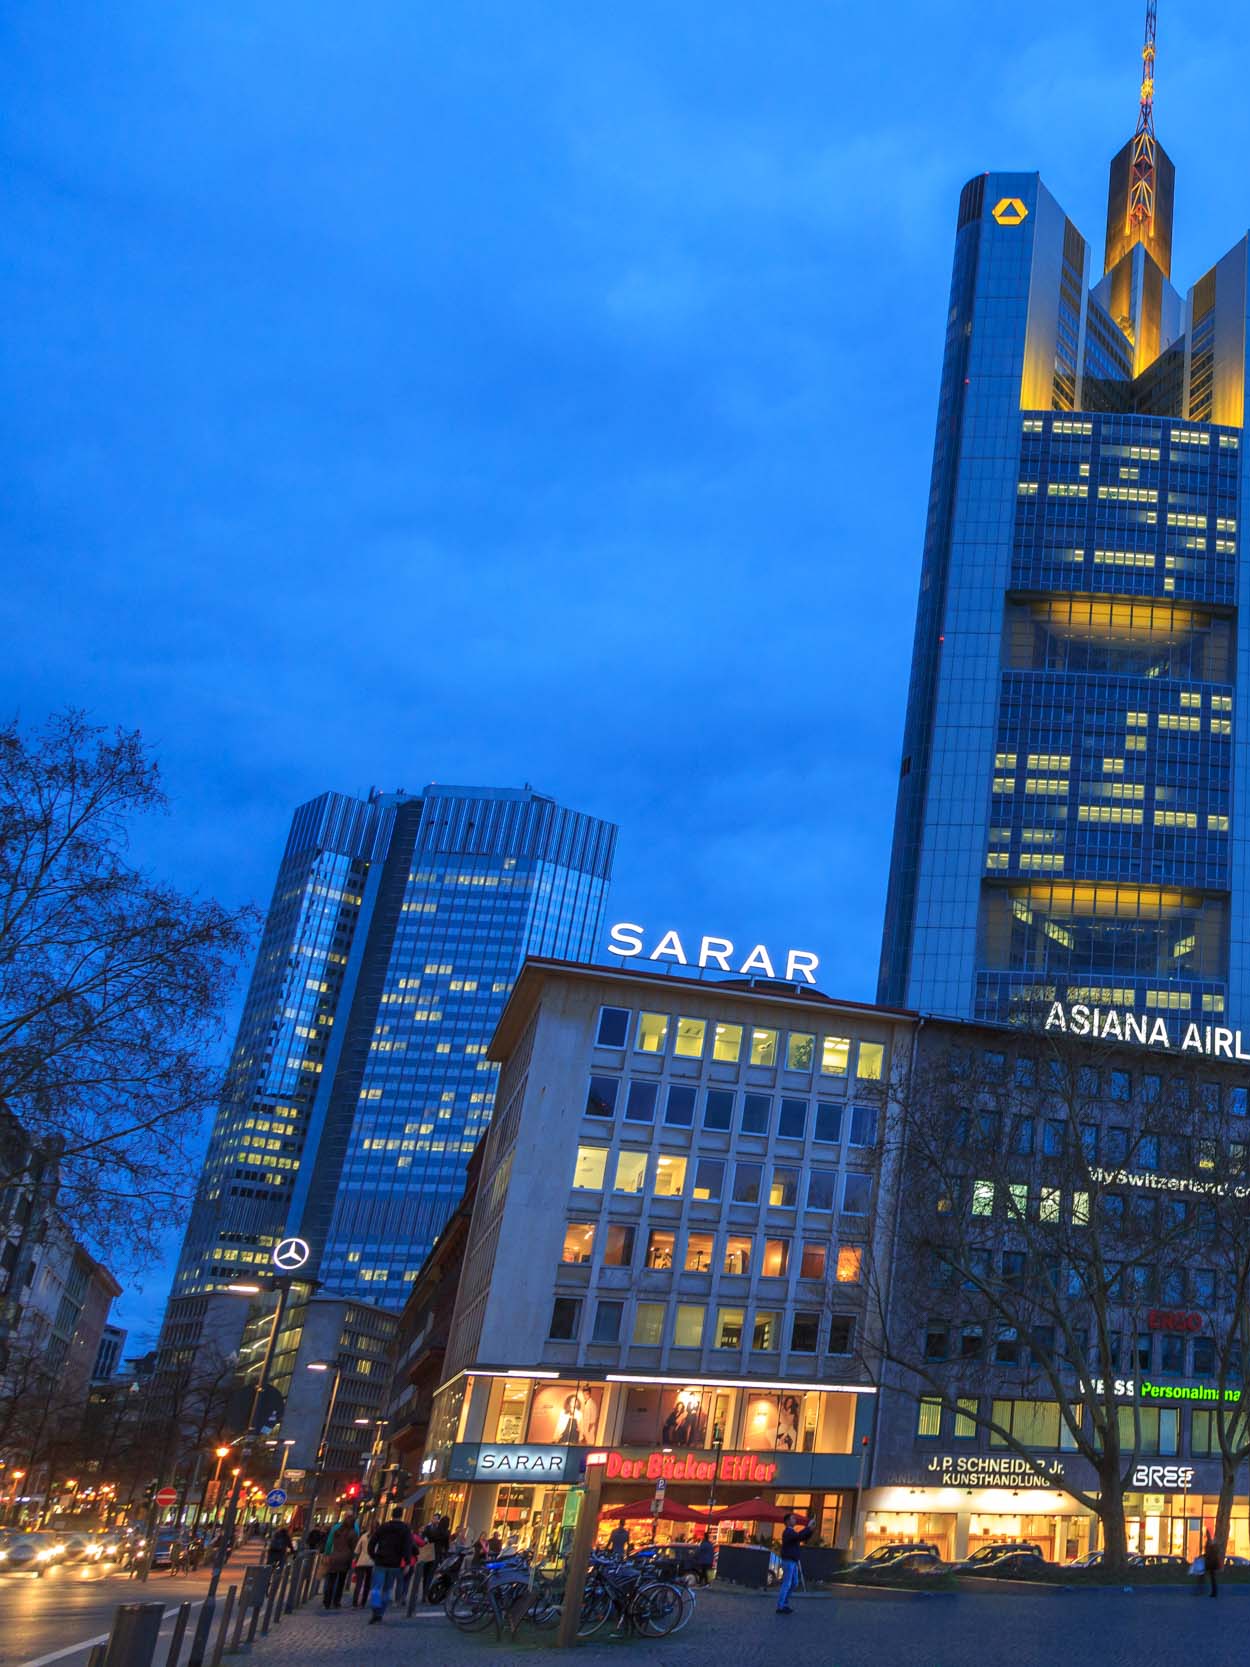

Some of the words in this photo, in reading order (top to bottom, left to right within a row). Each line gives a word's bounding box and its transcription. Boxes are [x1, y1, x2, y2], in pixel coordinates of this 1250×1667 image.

[607, 922, 820, 984] SARAR
[1044, 1001, 1170, 1048] ASIANA
[1079, 1378, 1135, 1396] ESS
[480, 1453, 563, 1471] SARAR
[606, 1452, 645, 1480] Der
[646, 1453, 716, 1480] Bäcker
[719, 1455, 777, 1482] Eifler
[1048, 1460, 1065, 1475] Jr.
[942, 1473, 1050, 1487] KUNSTHANDLUNG
[1132, 1465, 1194, 1488] BREE
